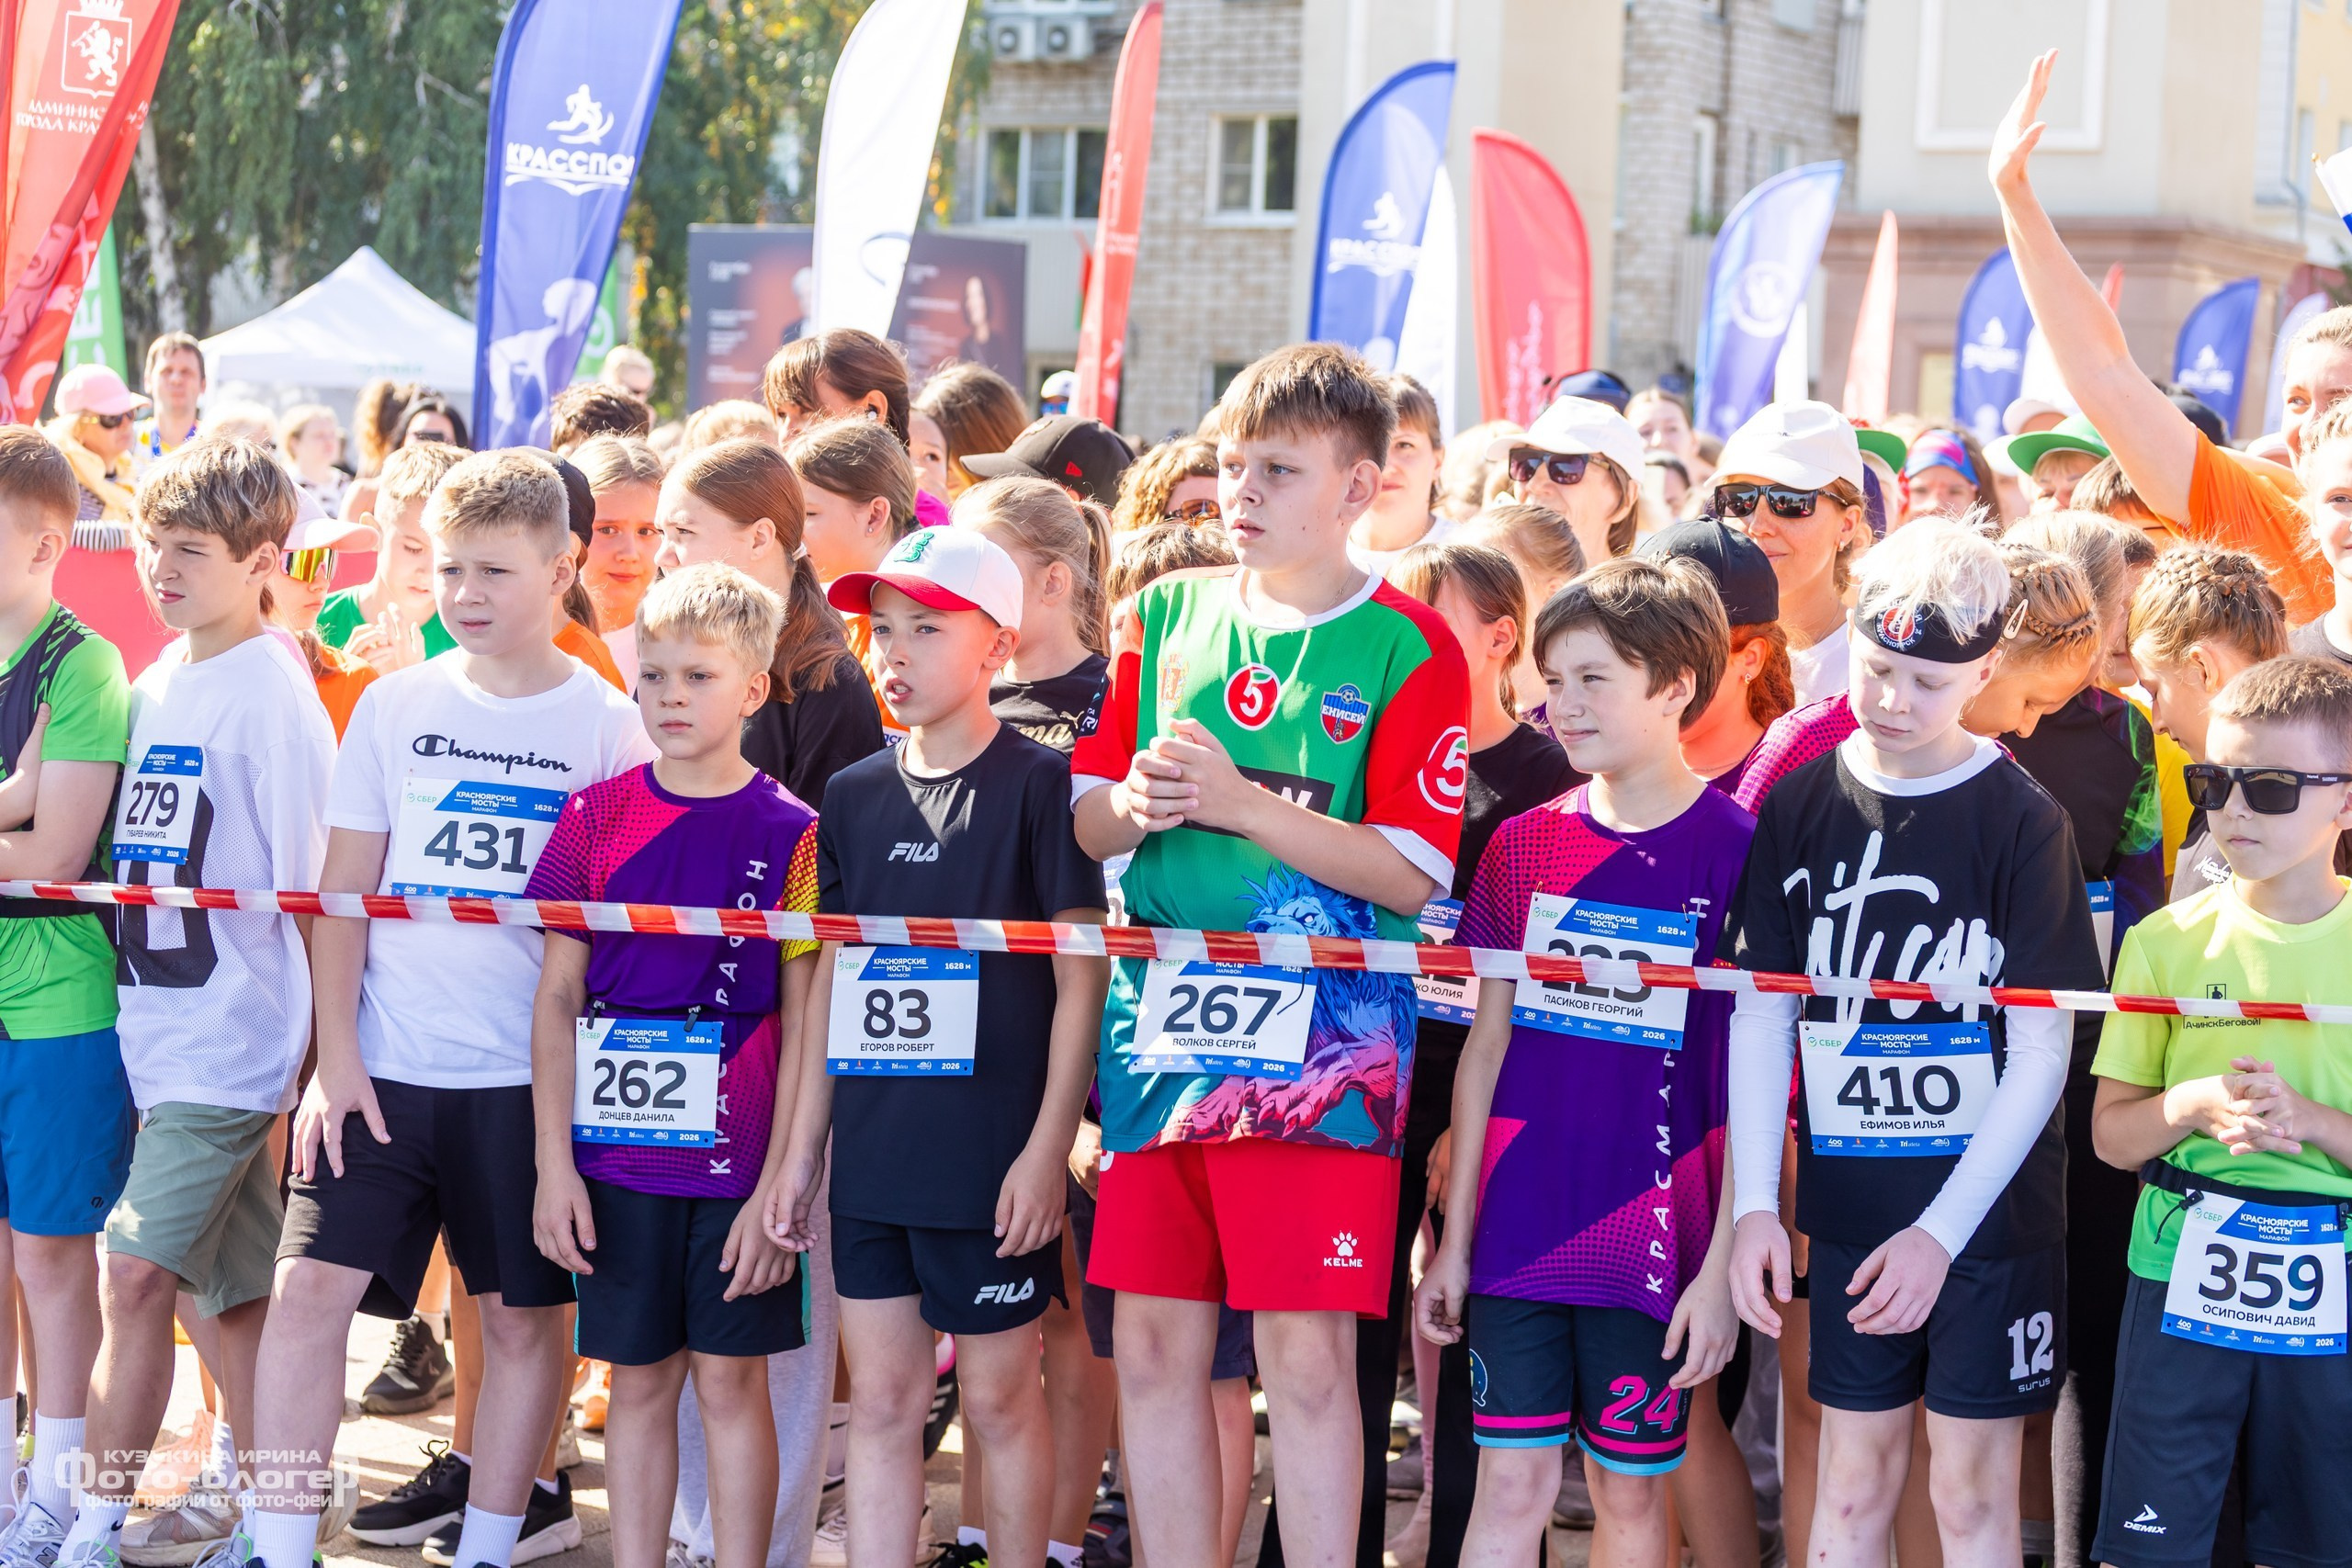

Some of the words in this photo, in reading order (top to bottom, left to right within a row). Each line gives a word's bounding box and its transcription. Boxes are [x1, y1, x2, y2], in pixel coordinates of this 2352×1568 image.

[1321, 705, 1366, 724] ЕНИСЕЙ
[412, 734, 571, 774] Champion
[456, 791, 517, 804] КРАСНОЯРСКИЕ
[471, 799, 499, 807] МОСТЫ
[125, 781, 179, 827] 279
[534, 804, 552, 812] 1628
[144, 830, 166, 839] НИКИТА
[424, 821, 527, 874] 431
[888, 842, 939, 862] FILA
[1421, 910, 1448, 920] МОСТЫ
[1541, 910, 1559, 919] СБЕР
[1575, 909, 1638, 925] КРАСНОЯРСКИЕ
[1589, 919, 1619, 930] МОСТЫ
[1657, 925, 1679, 935] 1628
[1590, 927, 1616, 936] МАРАФОН
[1163, 959, 1182, 968] СБЕР
[1431, 985, 1463, 999] ЮЛИЯ
[1162, 984, 1282, 1036] 267
[1544, 994, 1590, 1010] ПАСИКОВ
[1592, 1001, 1643, 1018] ГЕОРГИЙ
[864, 989, 932, 1039] 83
[614, 1029, 667, 1037] КРАСНОЯРСКИЕ
[1643, 1031, 1665, 1040] 2026
[1173, 1038, 1214, 1047] ВОЛКОВ
[1216, 1038, 1256, 1050] СЕРГЕЙ
[1263, 1063, 1285, 1072] 2026
[593, 1058, 687, 1109] 262
[1837, 1065, 1961, 1116] 410
[599, 1111, 632, 1121] ДОНЦЕВ
[633, 1113, 674, 1122] ДАНИЛА
[1861, 1121, 1911, 1130] ЕФИМОВ
[1913, 1120, 1945, 1129] ИЛЬЯ
[2203, 1212, 2222, 1222] СБЕР
[2241, 1213, 2308, 1227] КРАСНОЯРСКИЕ
[2259, 1226, 2292, 1235] МОСТЫ
[2321, 1224, 2334, 1232] 1628
[1324, 1258, 1363, 1267] KELME
[2199, 1243, 2324, 1311] 359
[974, 1277, 1035, 1304] FILA
[2203, 1304, 2272, 1324] ОСИПОВИЧ
[2274, 1316, 2315, 1327] ДАВИД
[2177, 1319, 2191, 1328] 400
[2008, 1311, 2053, 1380] 12
[2316, 1338, 2334, 1346] 2026
[1599, 1375, 1682, 1434] 24
[2124, 1521, 2166, 1534] DEMIX
